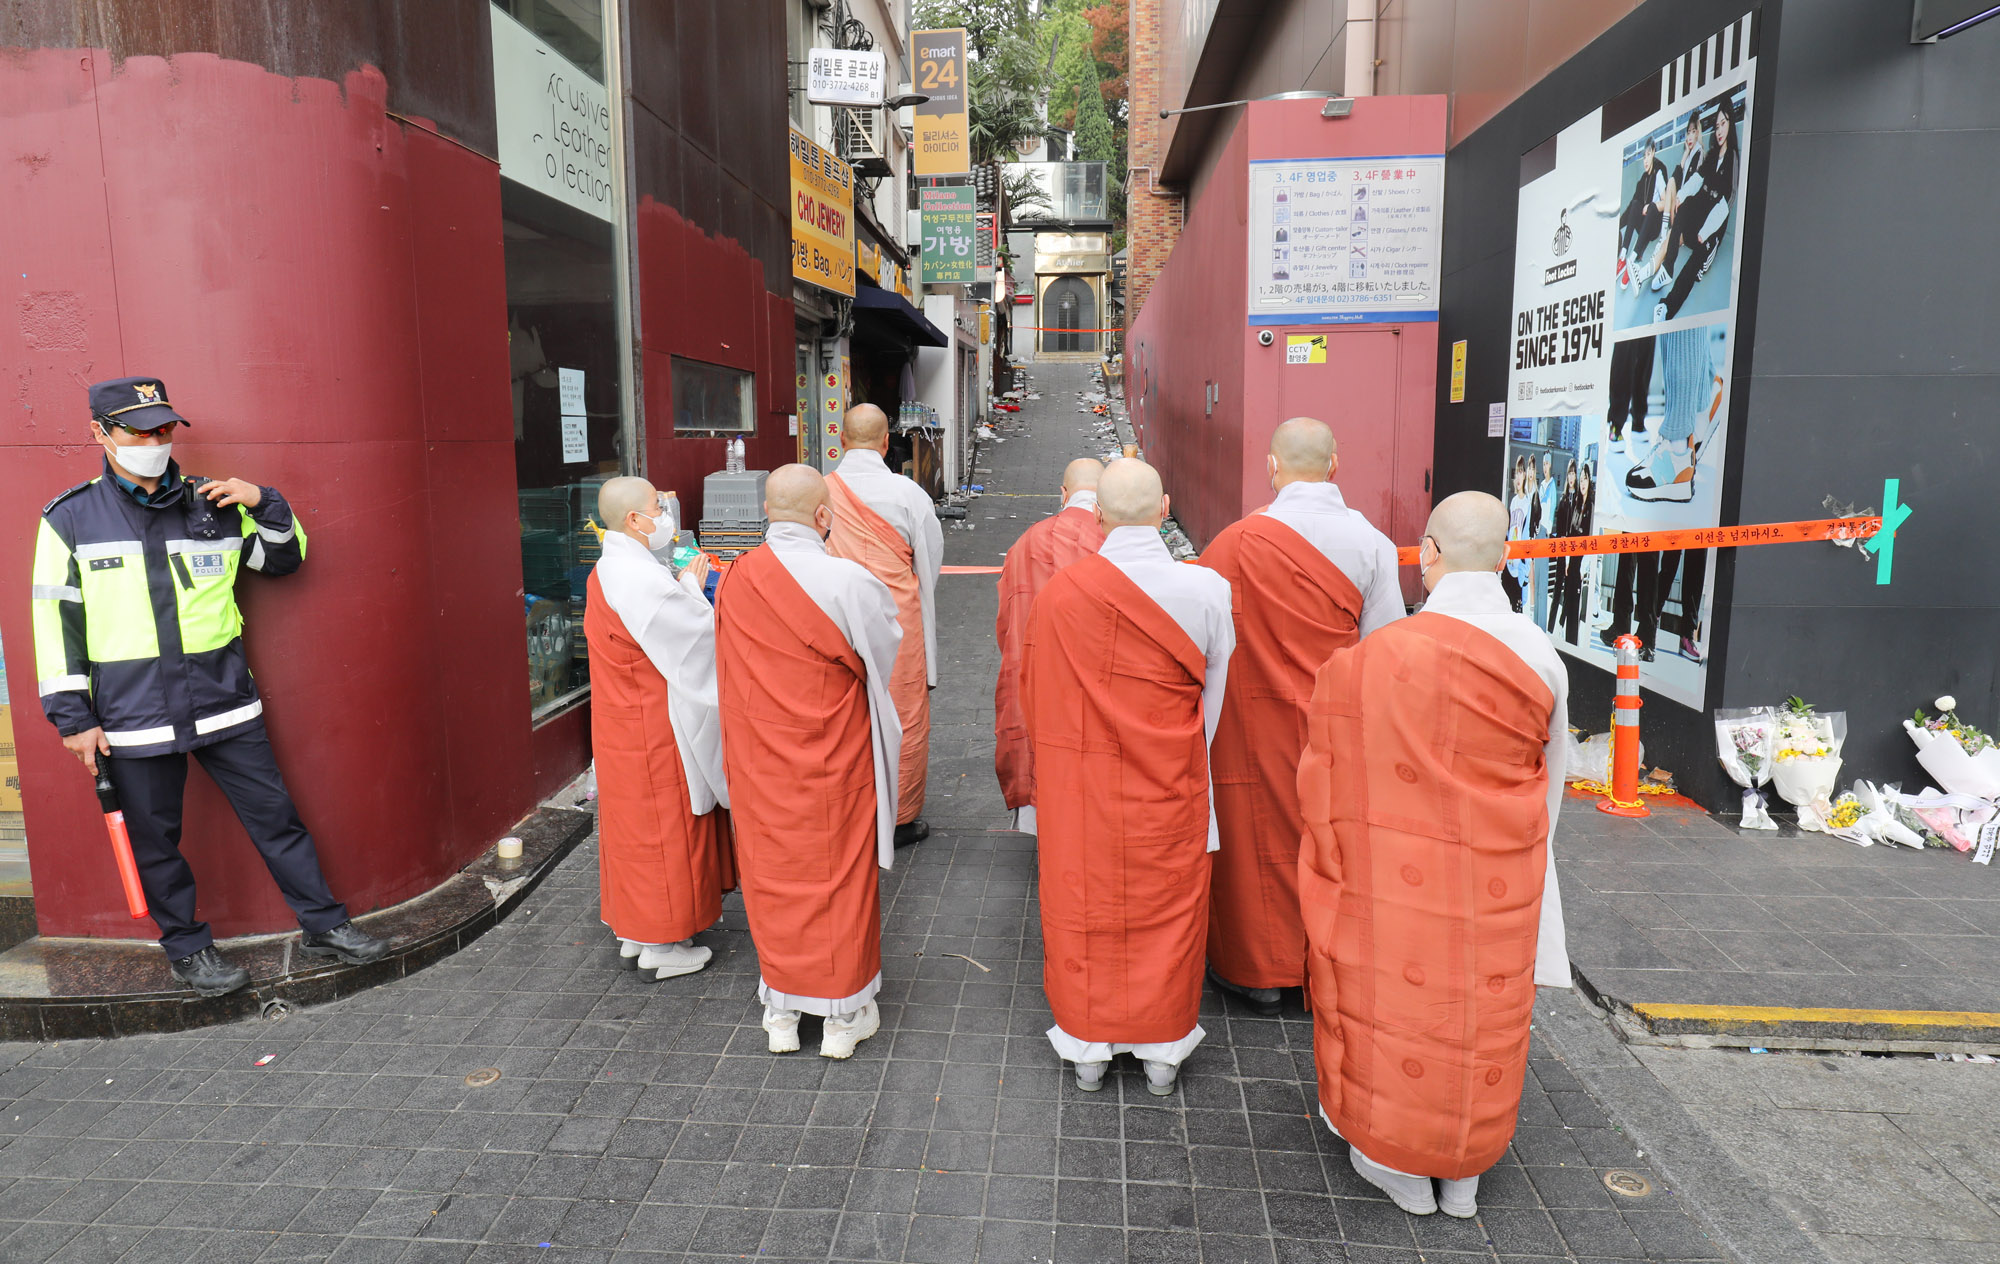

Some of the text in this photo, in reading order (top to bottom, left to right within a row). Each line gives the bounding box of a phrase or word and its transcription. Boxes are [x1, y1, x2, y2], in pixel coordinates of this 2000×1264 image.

[920, 46, 956, 58] emart
[813, 58, 878, 80] 해밀톤 골프샵
[920, 60, 959, 90] 24
[812, 80, 869, 92] 010-3772-4268
[923, 130, 959, 142] 딜리셔스
[924, 142, 959, 152] 아이디어
[790, 132, 849, 190] 해밀톤 골프샵
[1306, 170, 1336, 182] 영업중
[804, 167, 840, 199] 010-3772-4268
[923, 191, 957, 200] Milano
[923, 202, 972, 210] Collection
[798, 190, 846, 240] CHO JEWERY
[923, 214, 972, 224] 여성구두전문
[936, 226, 962, 234] 여행용
[924, 236, 972, 256] 가방
[1546, 264, 1576, 283] Foot Locker
[1296, 296, 1304, 304] 4F
[1518, 290, 1606, 336] ON THE SCENE
[1516, 322, 1604, 370] SINCE 1974
[1288, 354, 1308, 362] 촬영중
[1548, 539, 1598, 554] 경찰통제선
[1609, 536, 1650, 550] 경찰서장
[1694, 530, 1726, 544] 이선을
